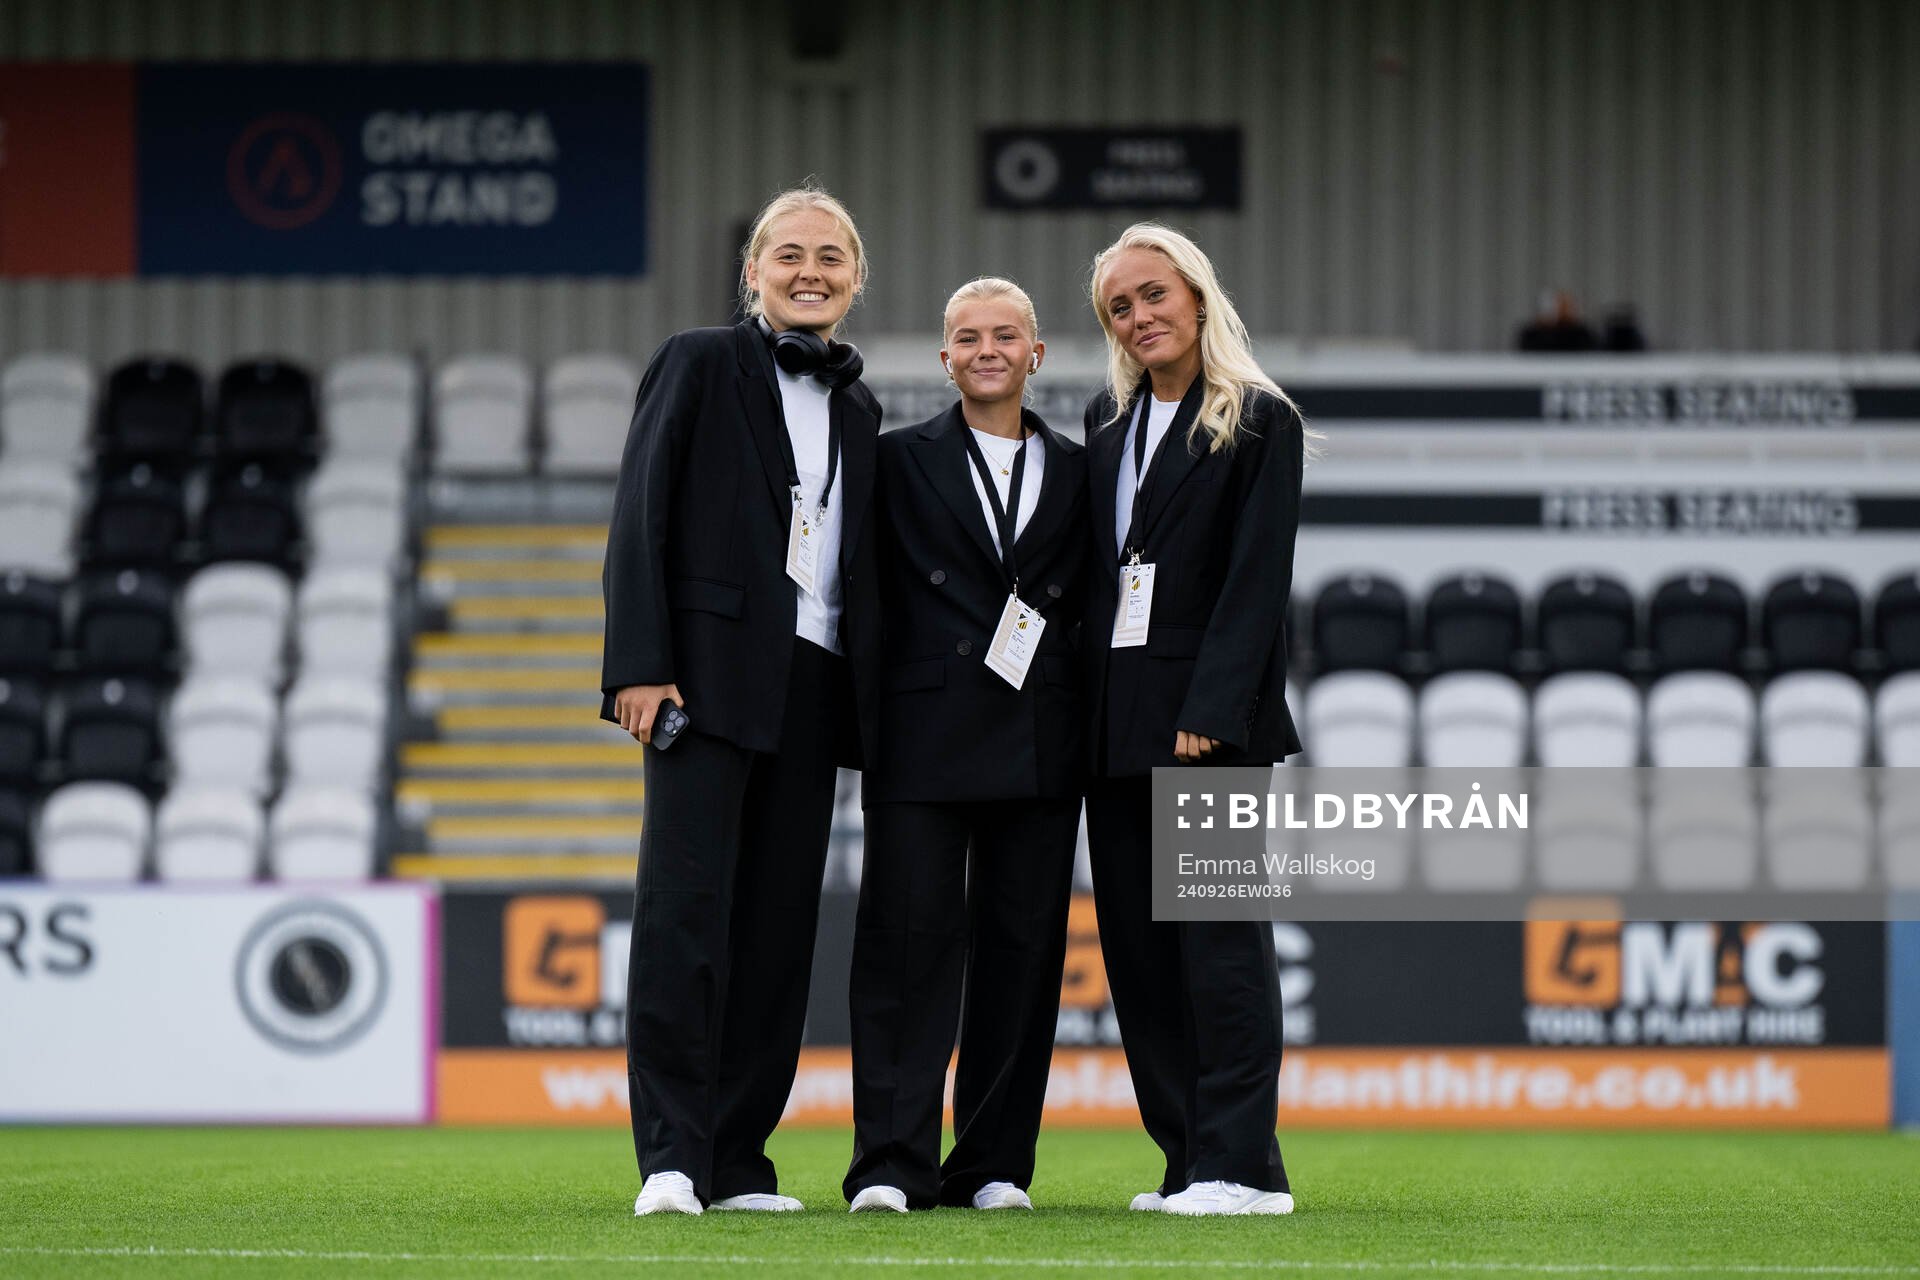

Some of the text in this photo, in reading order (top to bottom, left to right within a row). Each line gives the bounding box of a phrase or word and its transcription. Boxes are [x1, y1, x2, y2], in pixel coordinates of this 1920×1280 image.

[361, 111, 557, 163] OMEGA
[360, 172, 559, 227] STAND
[1541, 383, 1859, 425] PRESS SEATING
[1541, 491, 1861, 534] PRESS SEATING
